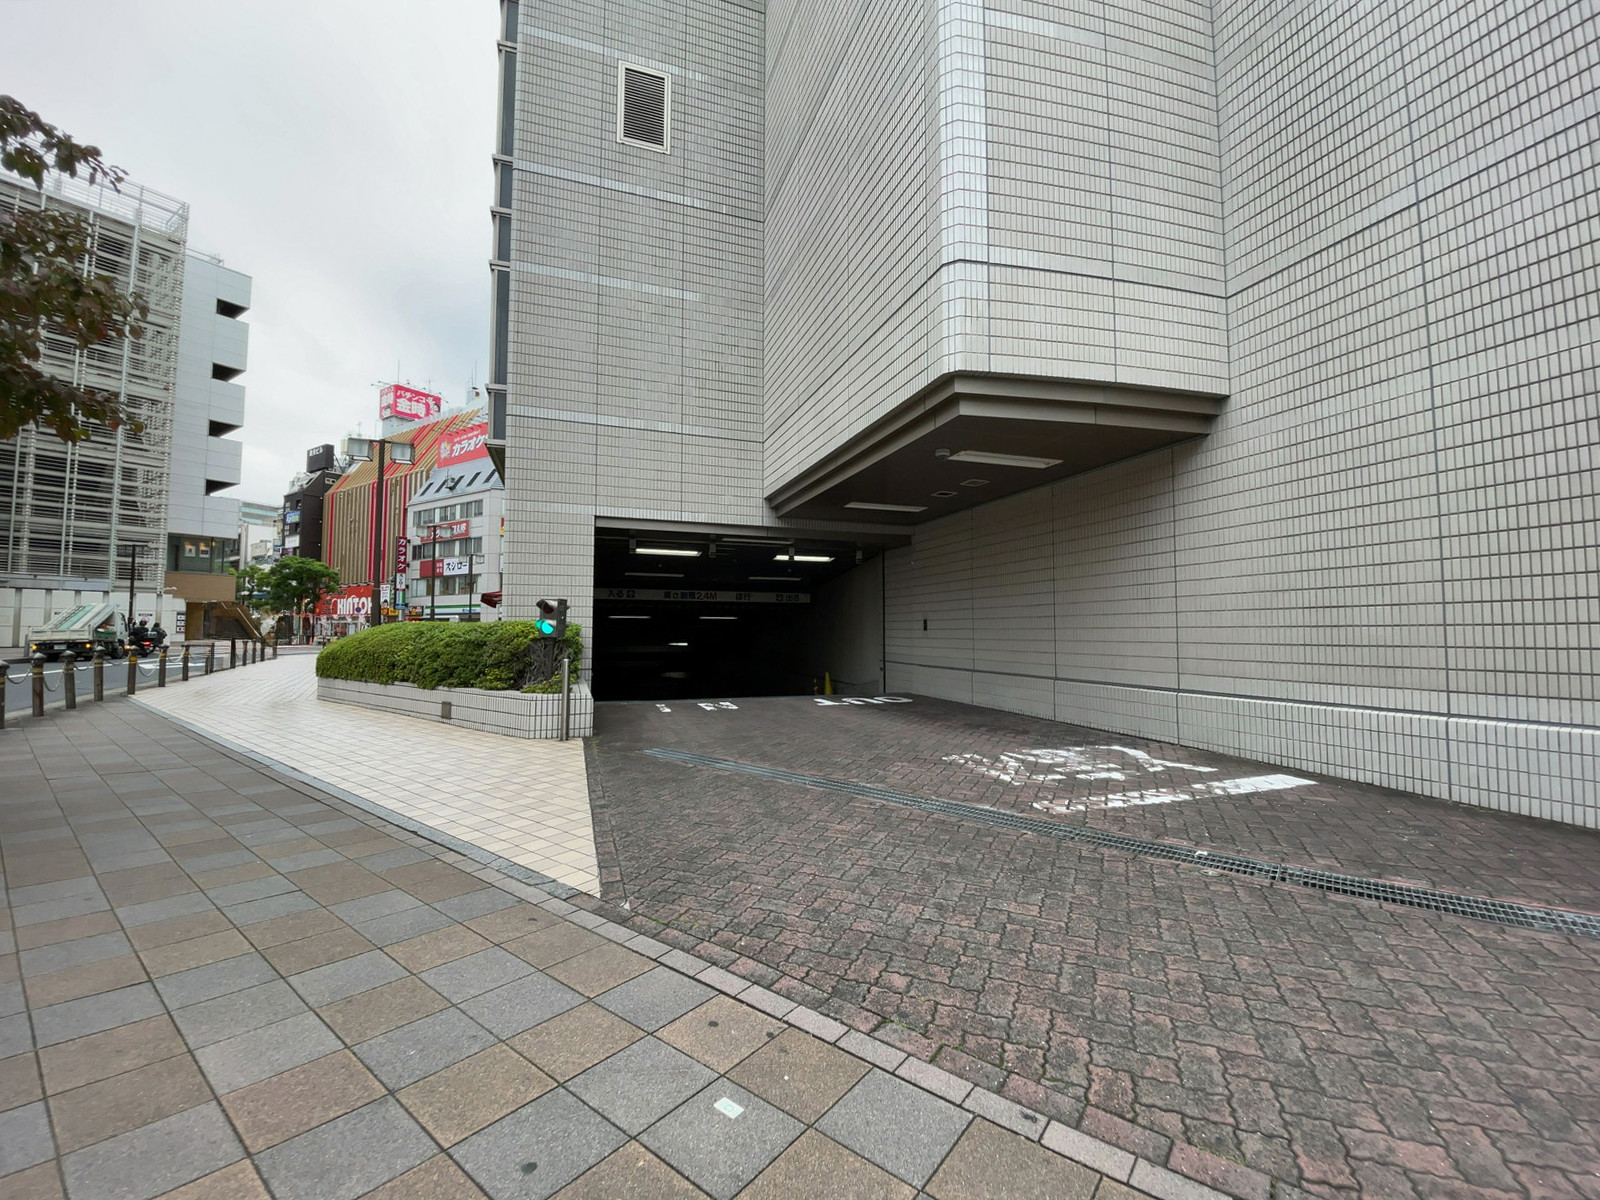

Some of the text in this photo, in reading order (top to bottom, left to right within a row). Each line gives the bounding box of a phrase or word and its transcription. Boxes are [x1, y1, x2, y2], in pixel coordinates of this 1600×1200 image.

[397, 390, 426, 403] パチンコ
[396, 398, 426, 417] 金時
[398, 538, 406, 570] カラオケ
[446, 562, 468, 572] スシロー
[814, 696, 913, 706] OUT
